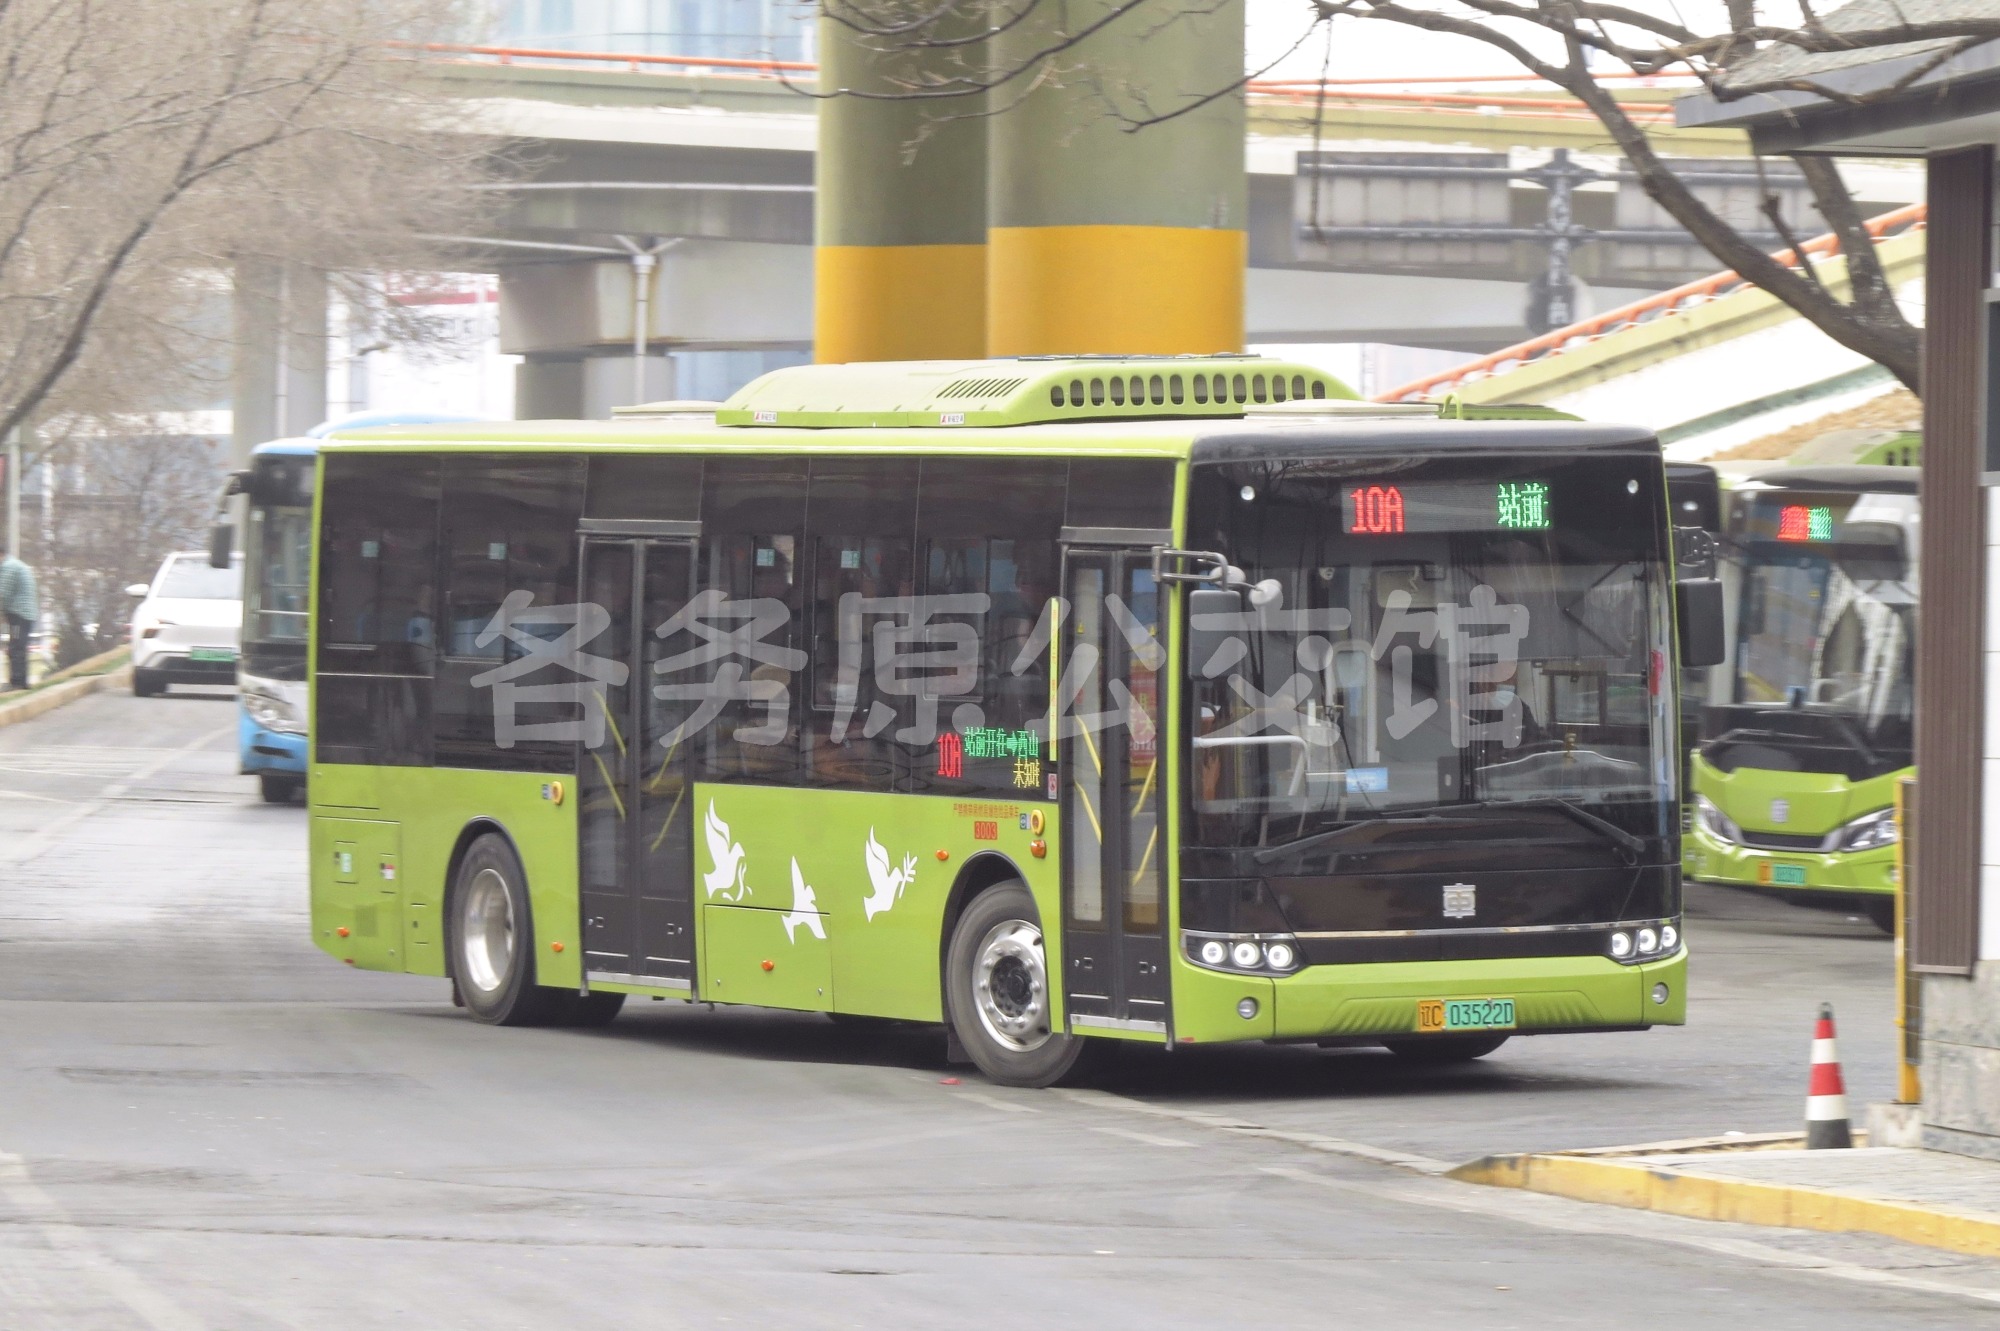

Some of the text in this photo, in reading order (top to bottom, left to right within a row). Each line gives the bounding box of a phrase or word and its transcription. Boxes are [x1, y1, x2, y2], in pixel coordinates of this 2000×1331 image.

[1350, 486, 1404, 533] 10A
[1498, 483, 1550, 528] 站前
[938, 732, 962, 778] 10A
